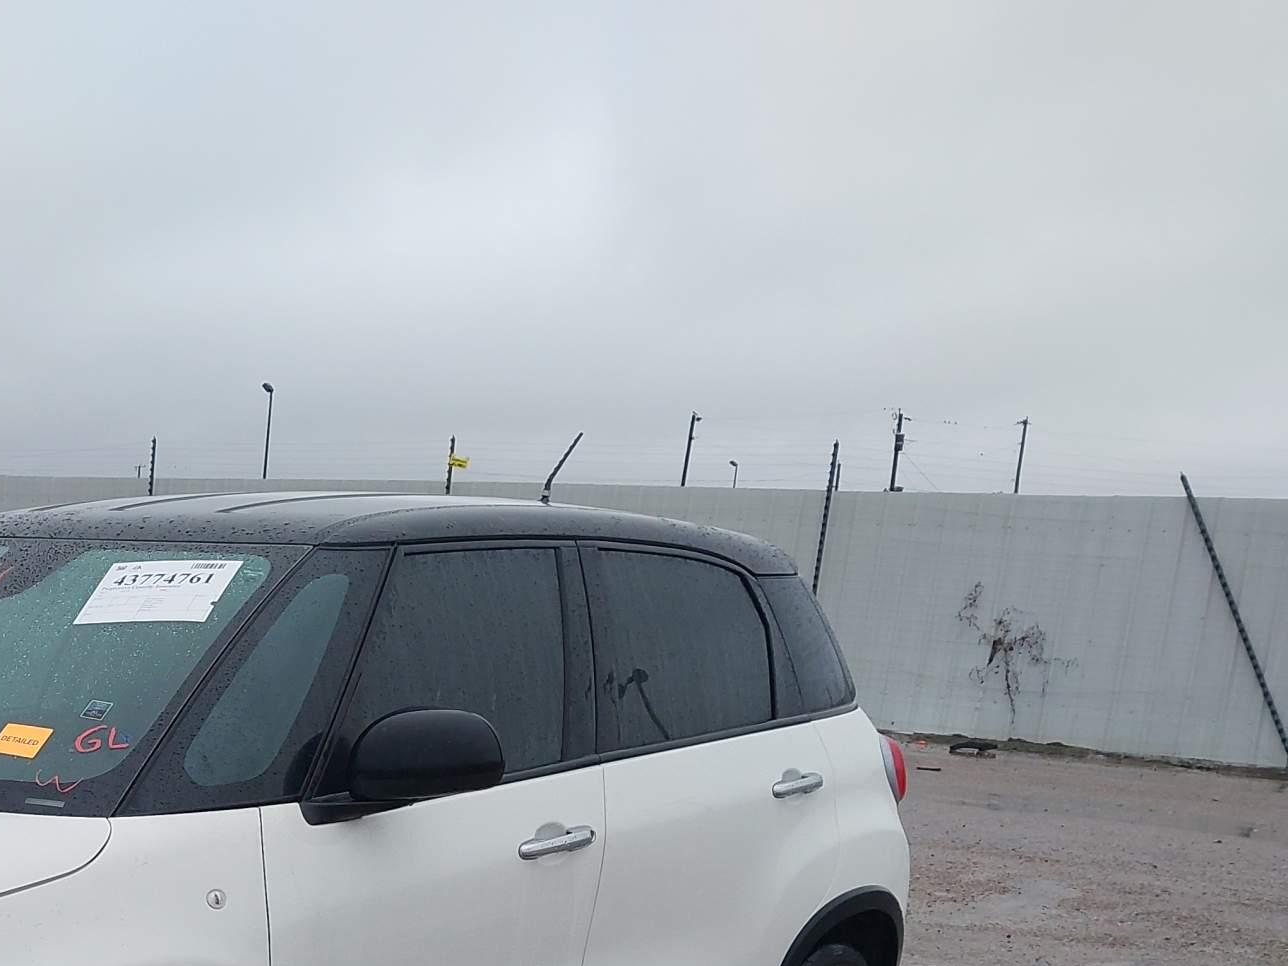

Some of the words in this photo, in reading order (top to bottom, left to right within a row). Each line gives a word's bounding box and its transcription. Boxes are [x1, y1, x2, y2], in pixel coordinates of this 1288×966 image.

[113, 573, 215, 586] 43774761
[0, 734, 40, 746] DETAILED
[75, 724, 129, 752] GL
